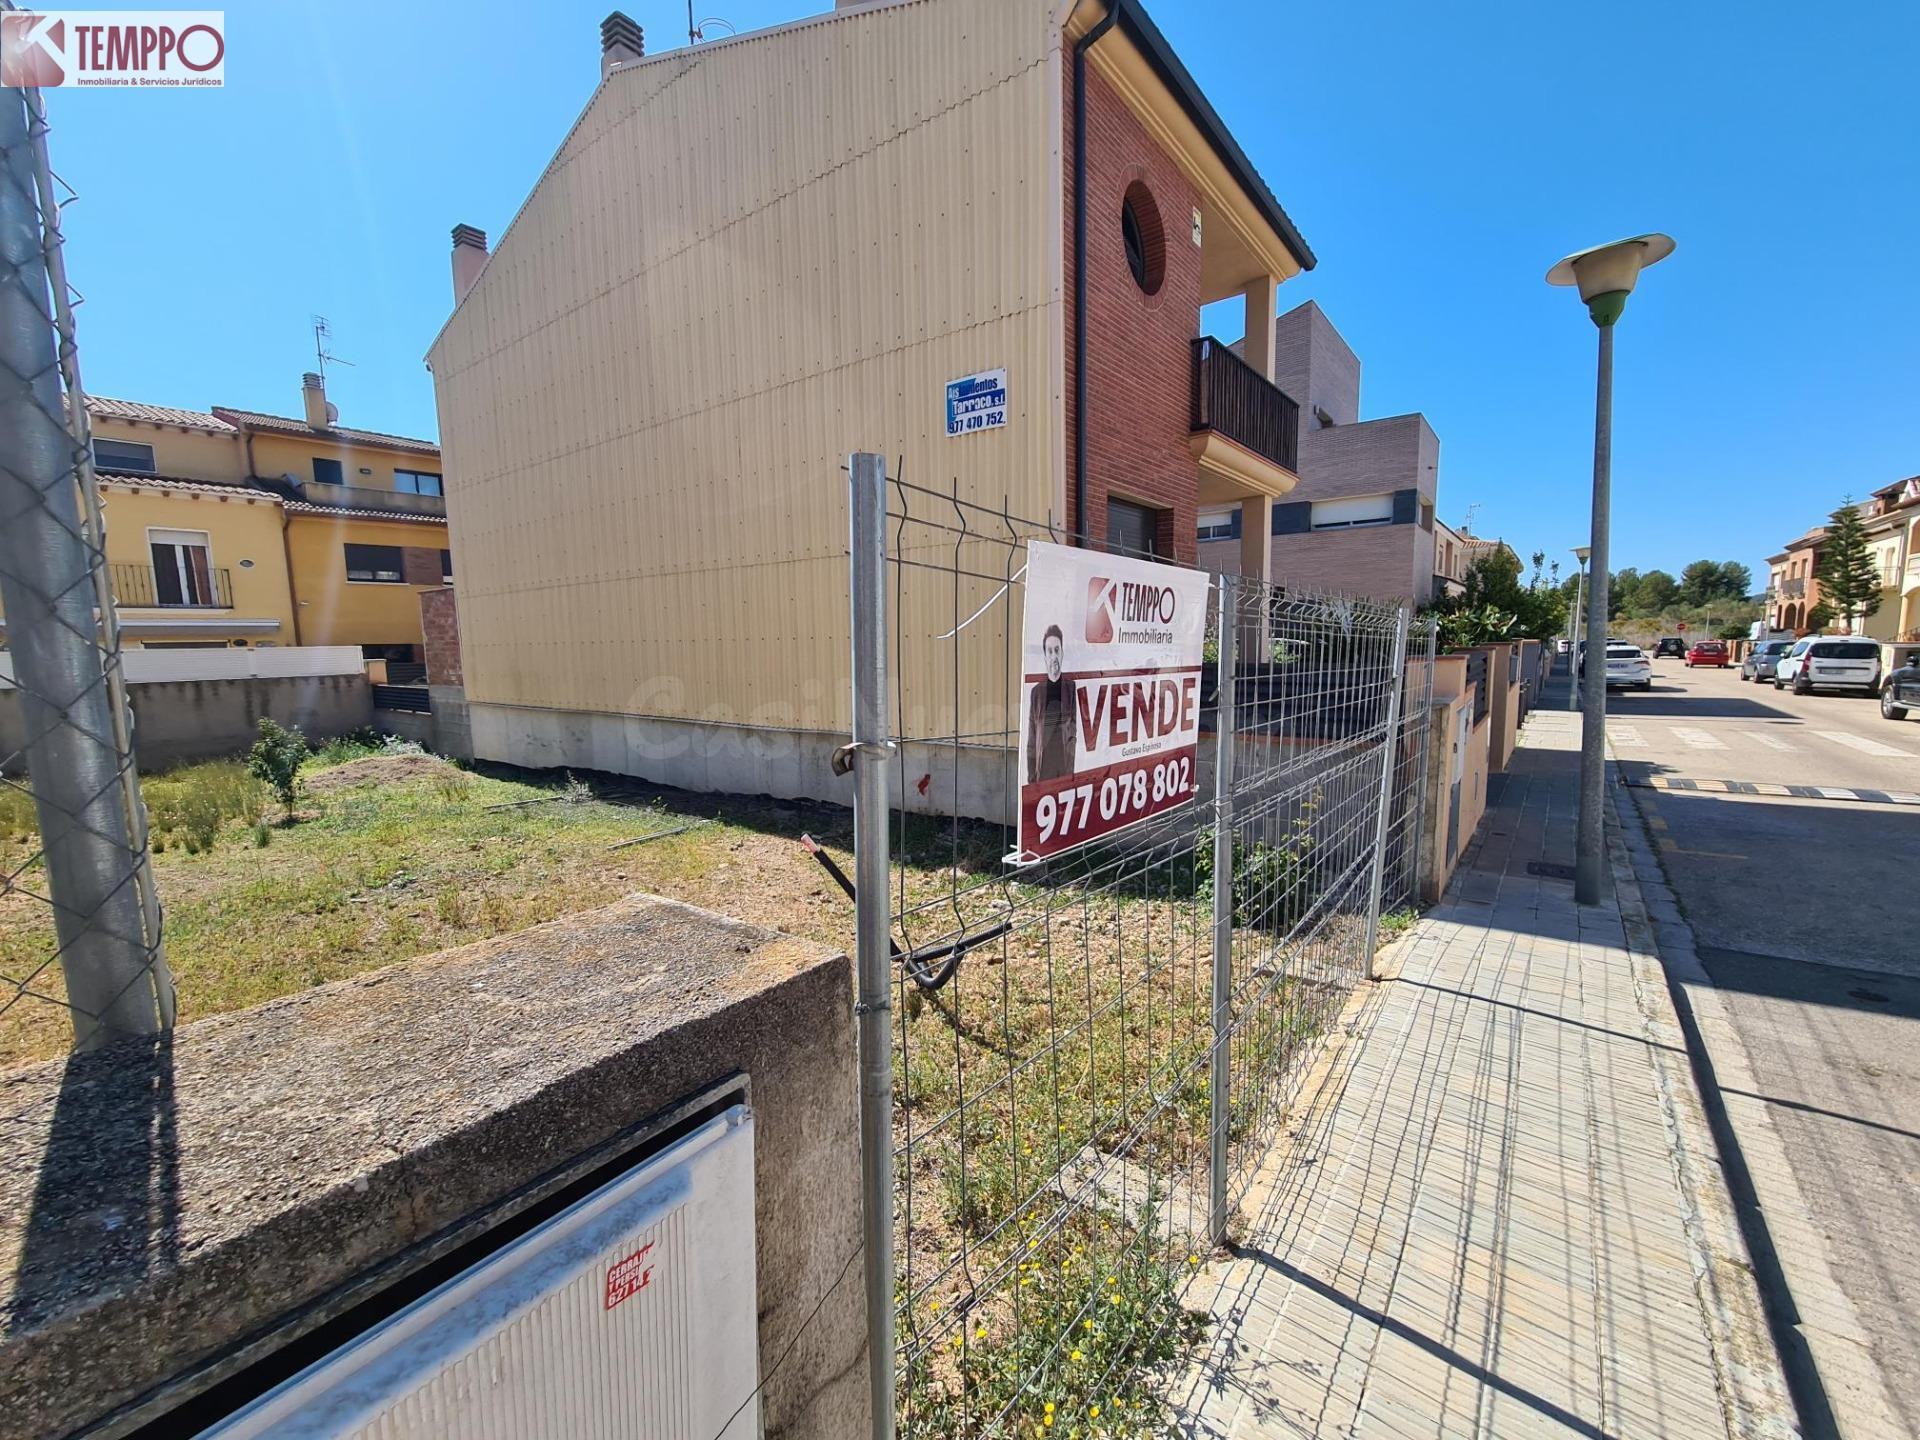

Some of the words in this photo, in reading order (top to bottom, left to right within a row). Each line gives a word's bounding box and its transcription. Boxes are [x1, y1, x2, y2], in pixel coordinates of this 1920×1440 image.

[966, 415, 983, 430] 470
[986, 411, 1004, 426] 752
[1121, 582, 1176, 624] TEMPPO
[1077, 677, 1197, 752] VENDE
[1036, 784, 1094, 844] 977
[1099, 769, 1147, 822] 078
[1152, 756, 1190, 802] 802
